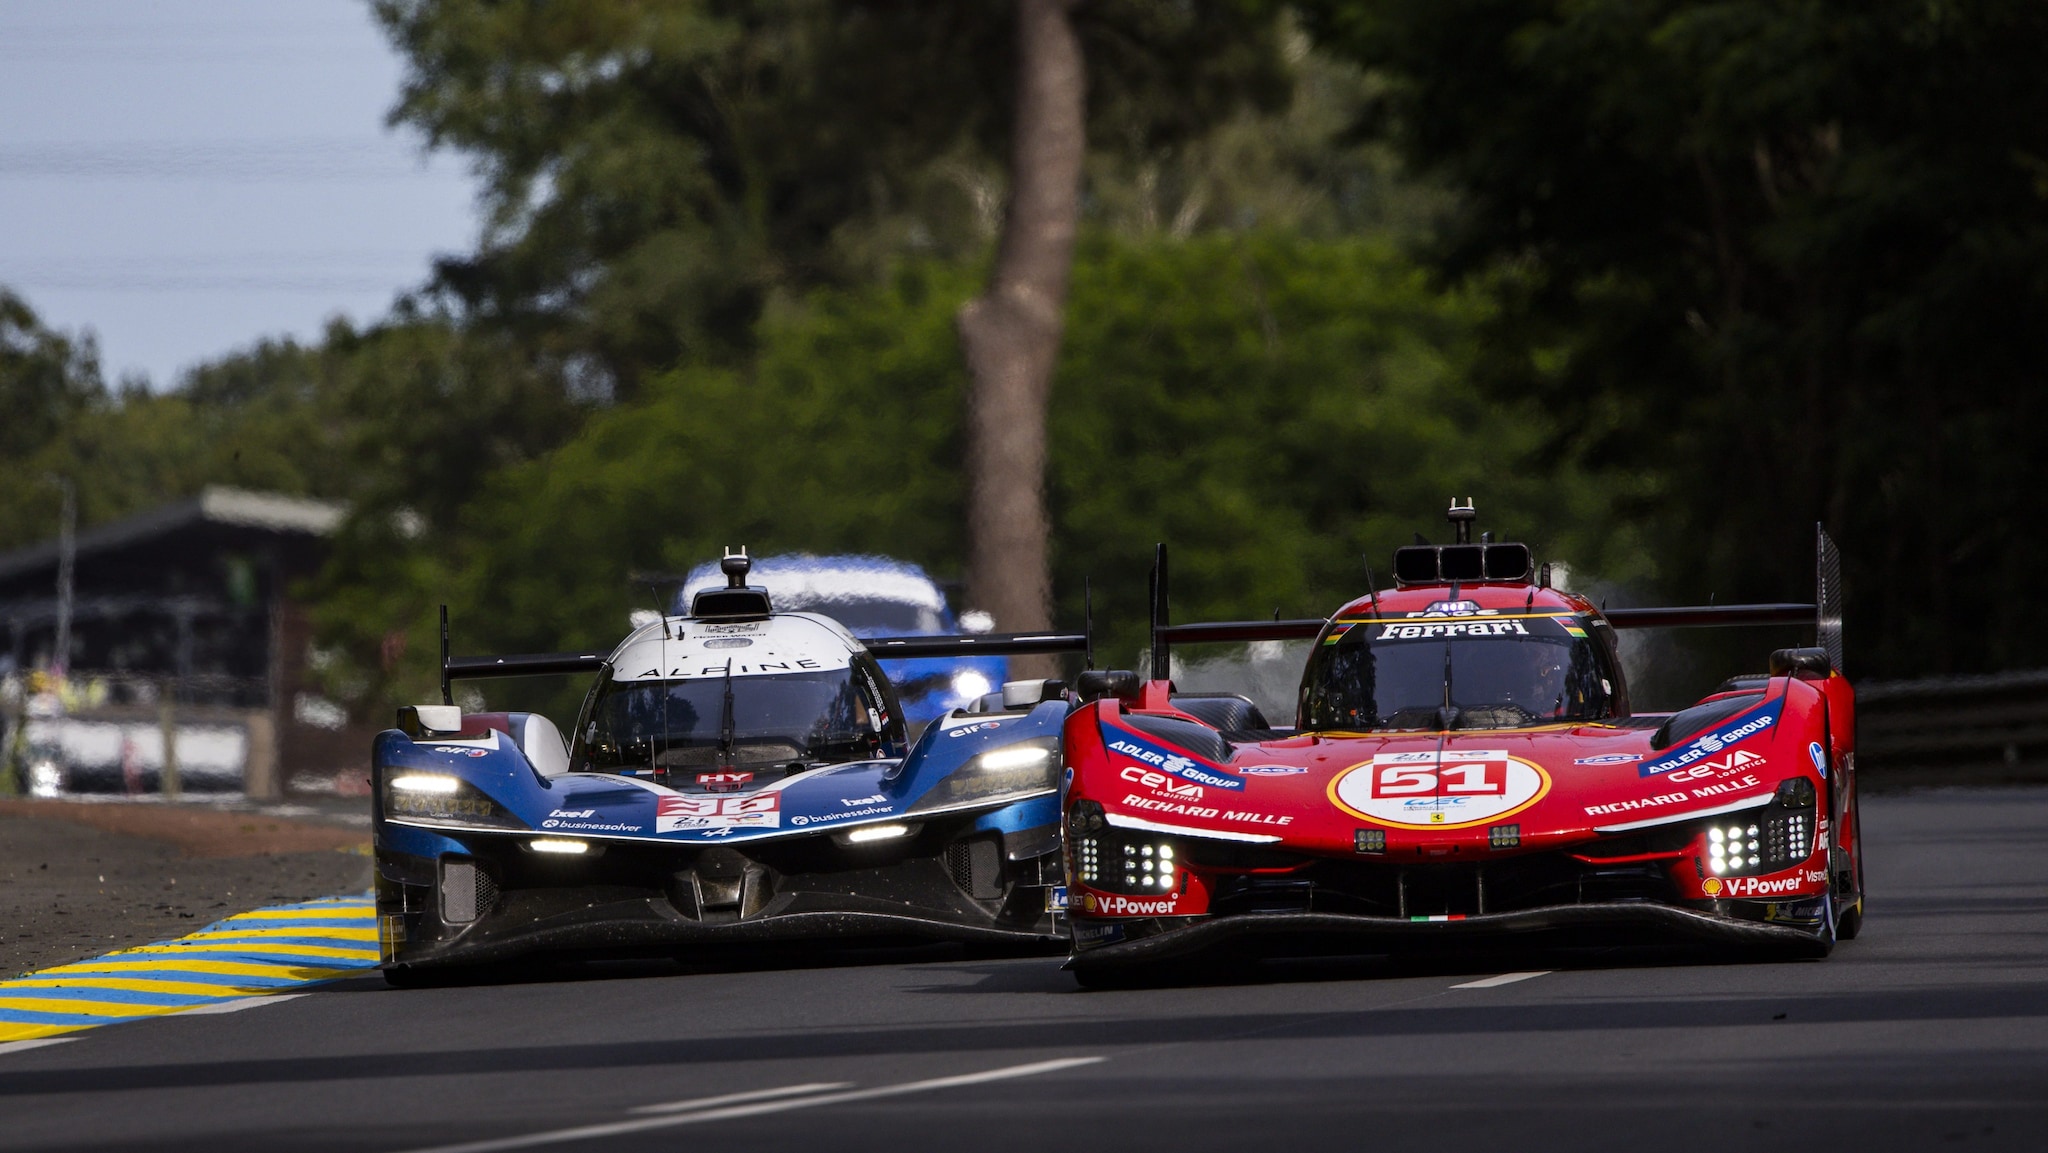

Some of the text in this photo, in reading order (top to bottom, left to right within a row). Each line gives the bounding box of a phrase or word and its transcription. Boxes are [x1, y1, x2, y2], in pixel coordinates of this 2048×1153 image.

[1378, 619, 1530, 640] Ferrari
[637, 658, 822, 678] ALPINE
[1648, 715, 1773, 774] ADLER GROUP
[1108, 740, 1240, 788] ADLER GROUP
[1716, 758, 1767, 779] LOGISTICS
[700, 773, 750, 782] HY
[1379, 763, 1498, 794] 51
[1151, 789, 1200, 803] LOGISTICS
[1584, 774, 1761, 816] RICHARD MILLE
[808, 805, 894, 823] businessolver
[1122, 793, 1294, 826] RICHARD MILLE
[559, 821, 643, 832] businessolver
[1725, 876, 1803, 896] V-Power
[1098, 896, 1177, 914] V-Power
